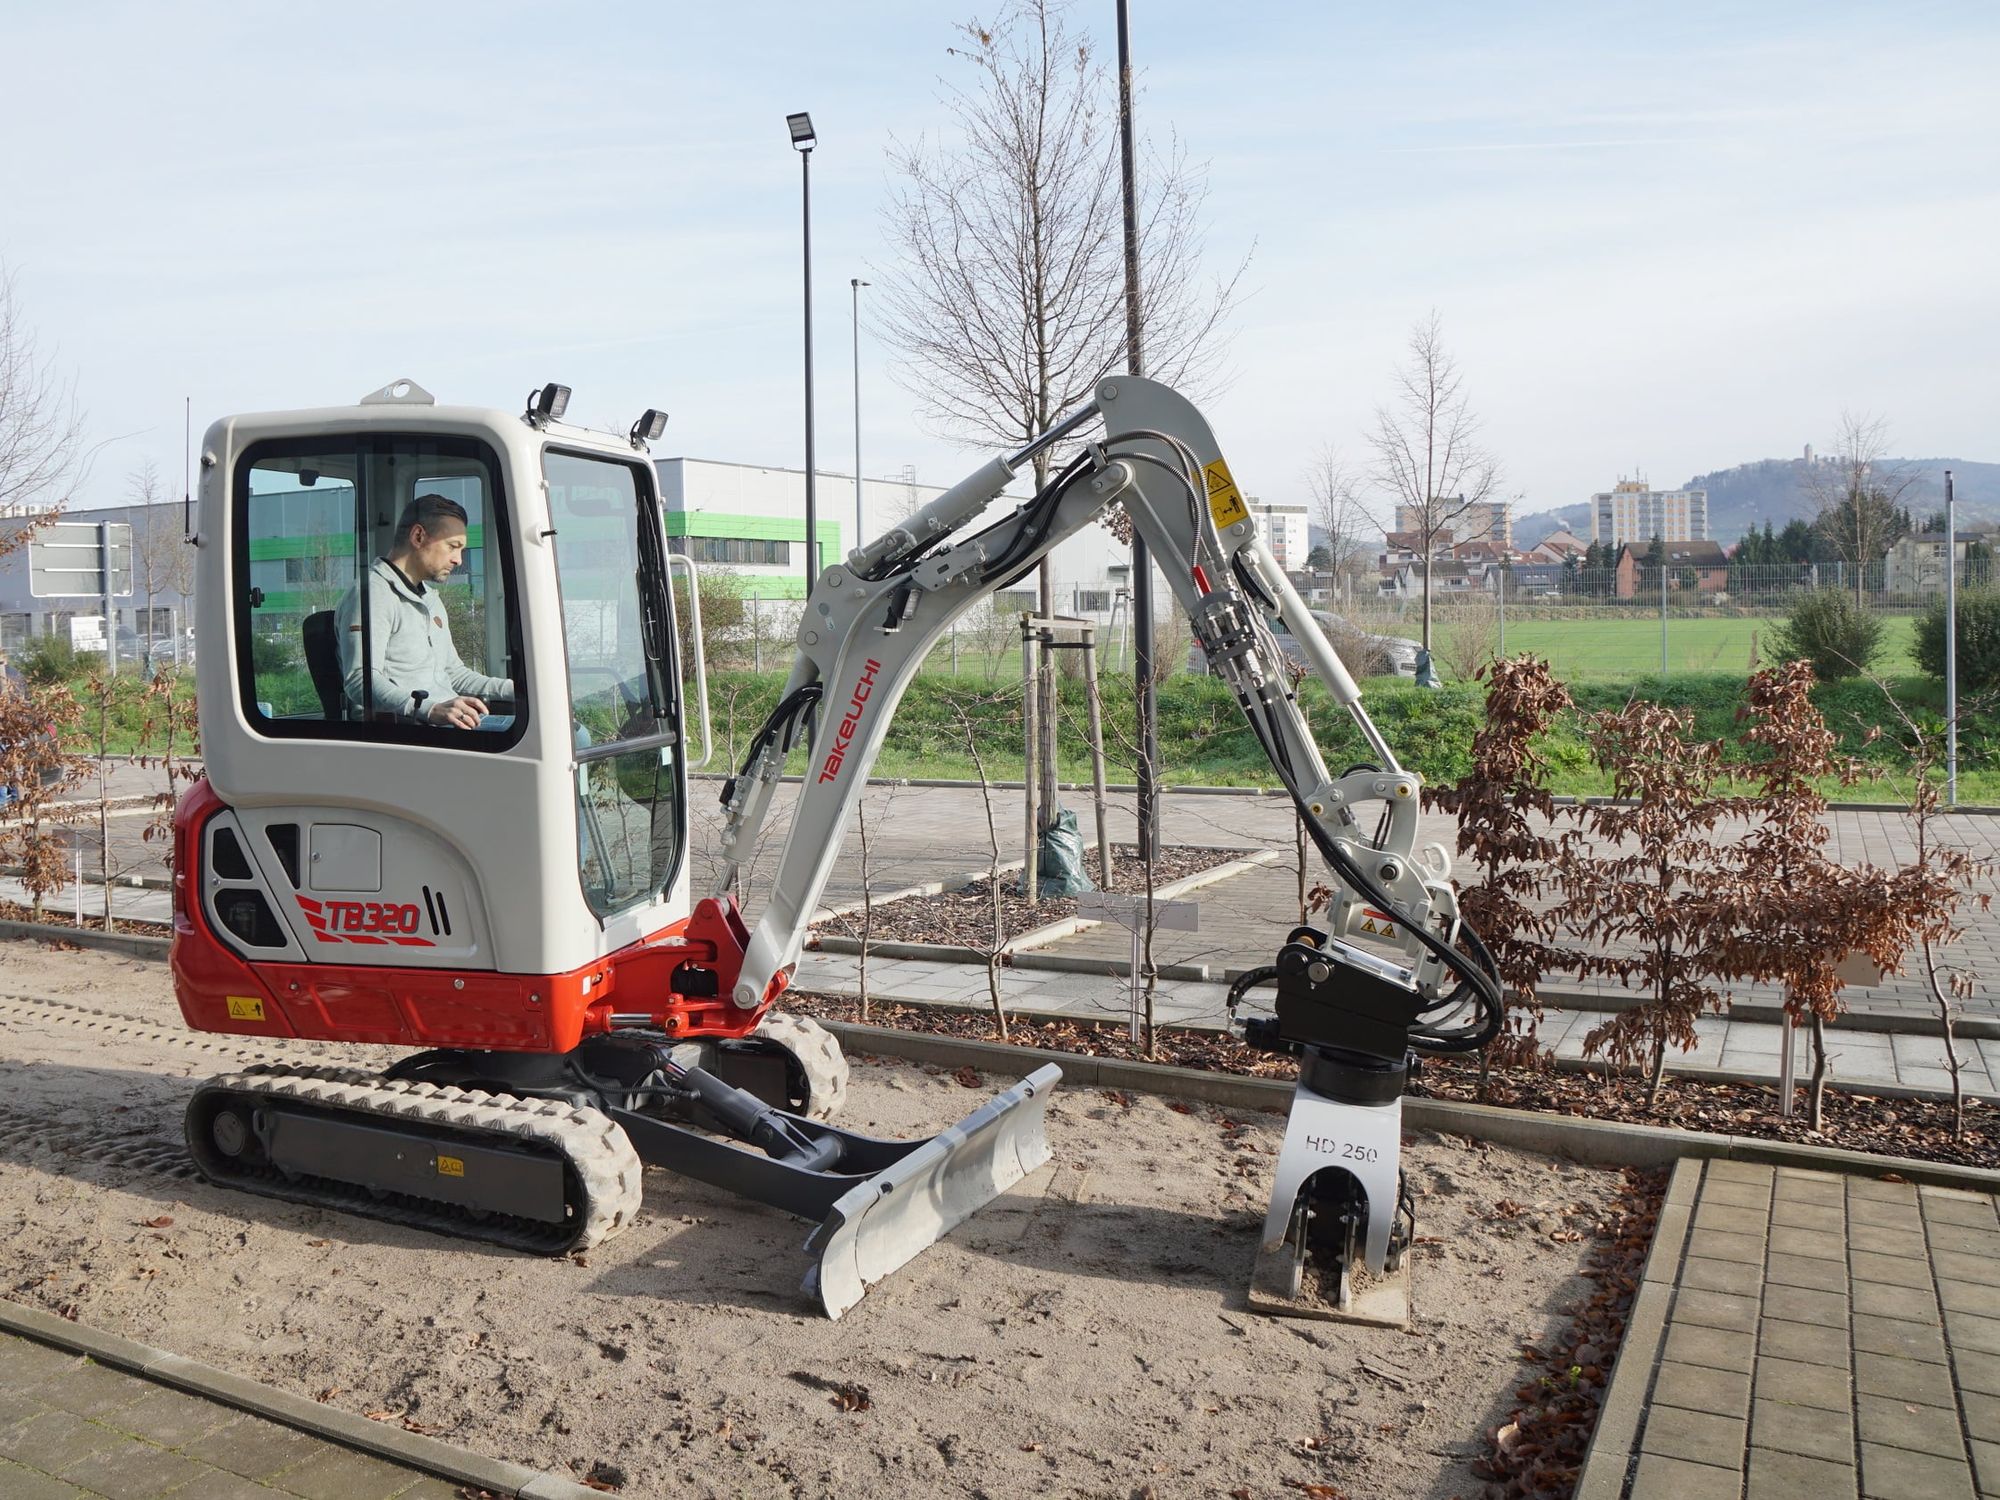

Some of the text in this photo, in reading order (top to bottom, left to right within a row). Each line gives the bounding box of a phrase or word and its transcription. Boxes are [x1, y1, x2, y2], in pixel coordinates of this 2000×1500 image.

[325, 901, 420, 934] TB320
[1306, 1135, 1377, 1162] HD 250
